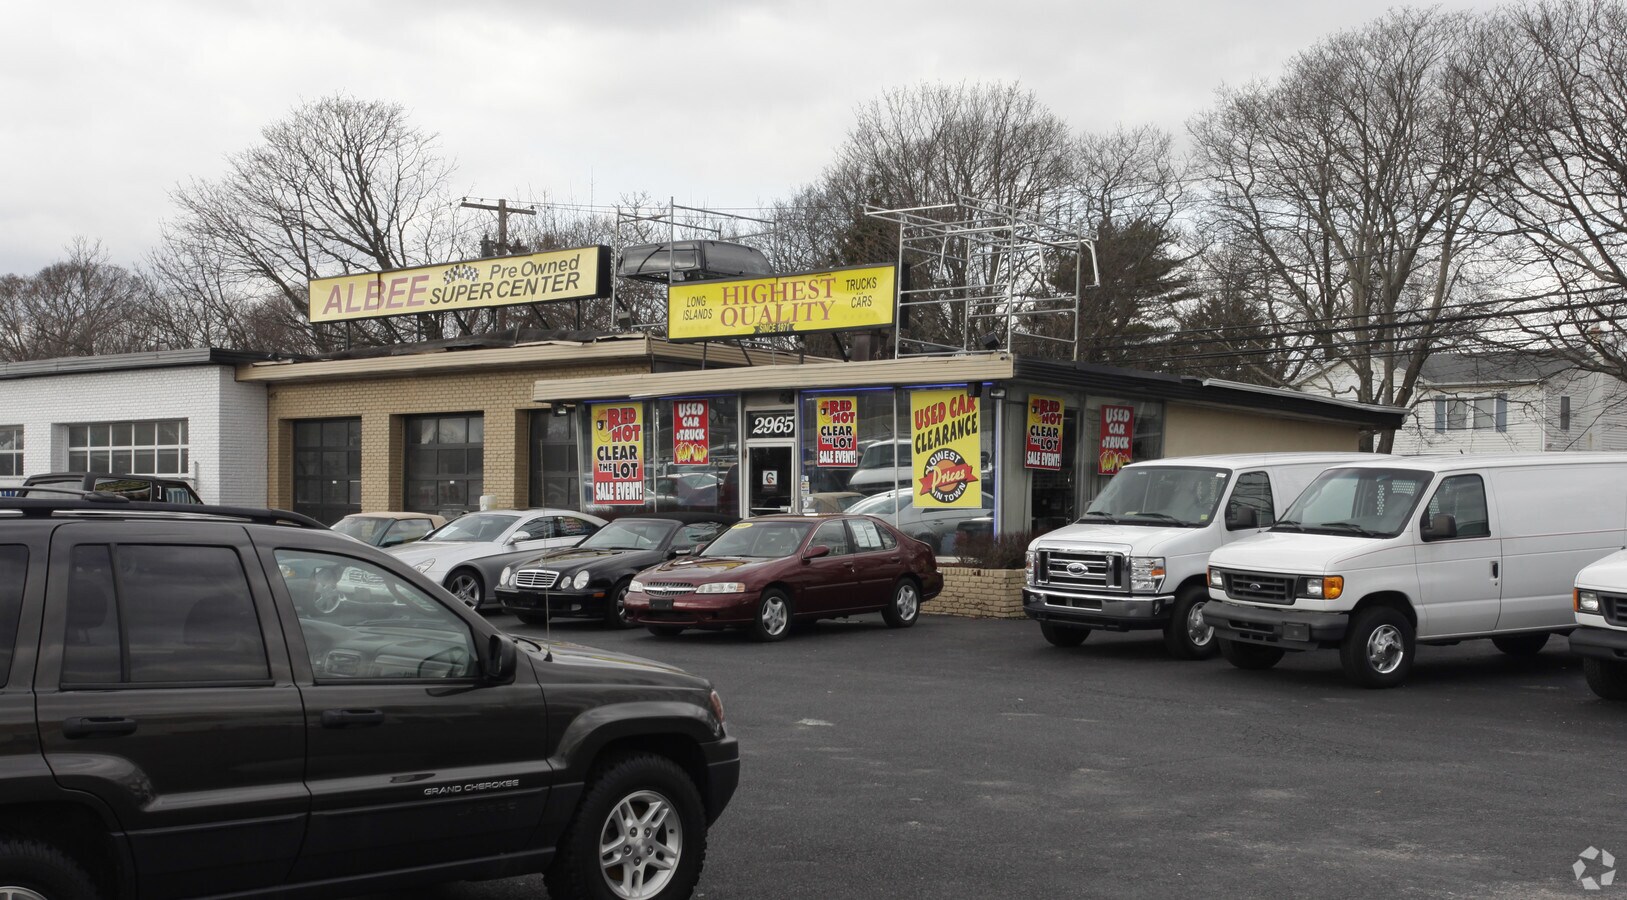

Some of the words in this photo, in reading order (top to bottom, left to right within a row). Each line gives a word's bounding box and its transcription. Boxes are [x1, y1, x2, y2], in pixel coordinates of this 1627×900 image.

[490, 263, 518, 280] Pre
[521, 254, 580, 276] Owned
[721, 277, 837, 306] HIGHEST
[845, 277, 877, 292] TRUCKS
[322, 275, 429, 314] ALBEE
[686, 295, 706, 307] LONG
[850, 295, 873, 309] CARS
[682, 308, 713, 321] ISLANDS
[720, 300, 836, 328] QUALITY
[678, 403, 704, 418] USED
[829, 400, 852, 416] RED
[914, 402, 947, 431] USED
[950, 394, 977, 419] CAR
[1039, 399, 1060, 415] RED
[607, 407, 637, 431] RED
[682, 416, 700, 428] CAR
[832, 412, 856, 424] HOT
[1041, 413, 1062, 425] HOT
[1106, 408, 1130, 423] USED
[611, 424, 641, 442] HOT
[752, 416, 795, 434] 2965
[820, 425, 853, 437] CLEAR
[1030, 425, 1059, 439] CLEAR
[1109, 423, 1125, 435] CAR
[914, 412, 978, 455] CLEARANCE
[822, 437, 833, 445] THE
[833, 436, 853, 449] LOT
[1030, 437, 1041, 445] THE
[1041, 437, 1059, 451] LOT
[597, 445, 638, 461] CLEAR
[819, 450, 834, 464] SALE
[835, 450, 856, 465] EVENT!
[1027, 451, 1041, 466] SALE
[1041, 452, 1061, 467] EVENT!
[598, 463, 612, 472] THE
[613, 462, 638, 478] LOT
[925, 450, 961, 475] LOWEST
[931, 465, 966, 494] Prices
[595, 481, 614, 501] SALE
[616, 480, 643, 501] EVENT!
[934, 490, 943, 500] IN
[945, 482, 966, 502] TOWN
[424, 785, 462, 796] GRAND
[464, 779, 520, 791] CHEROKEE
